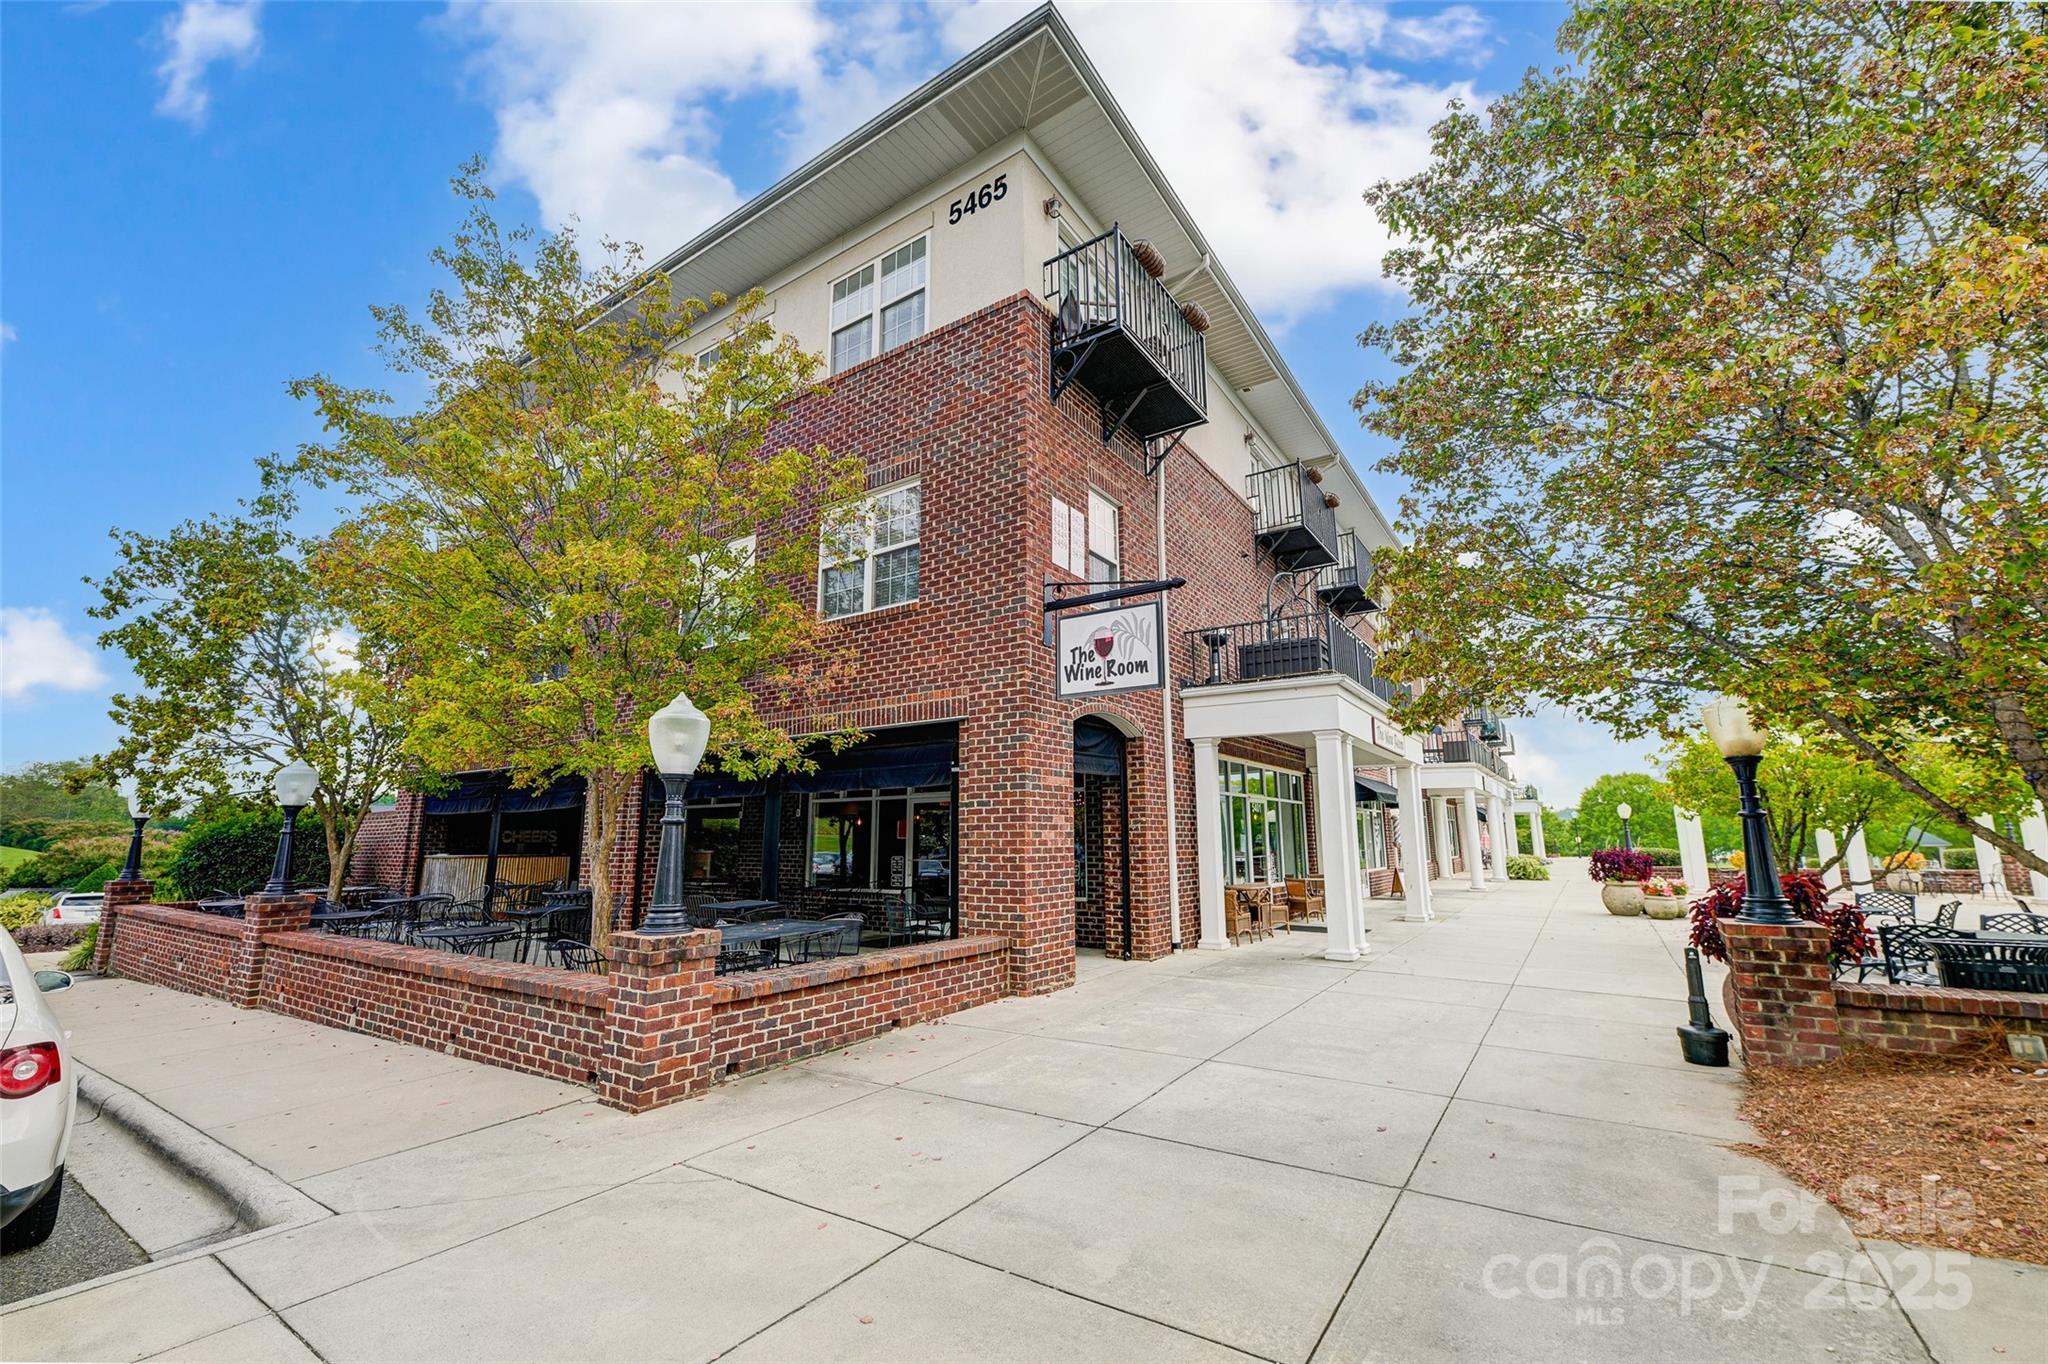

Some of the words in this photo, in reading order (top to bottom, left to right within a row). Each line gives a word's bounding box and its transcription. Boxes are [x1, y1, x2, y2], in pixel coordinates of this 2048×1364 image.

[949, 173, 1008, 225] 5465
[1070, 646, 1096, 665] The
[1064, 663, 1102, 683] Wine
[1106, 659, 1149, 678] Room
[502, 830, 558, 844] CHEERS
